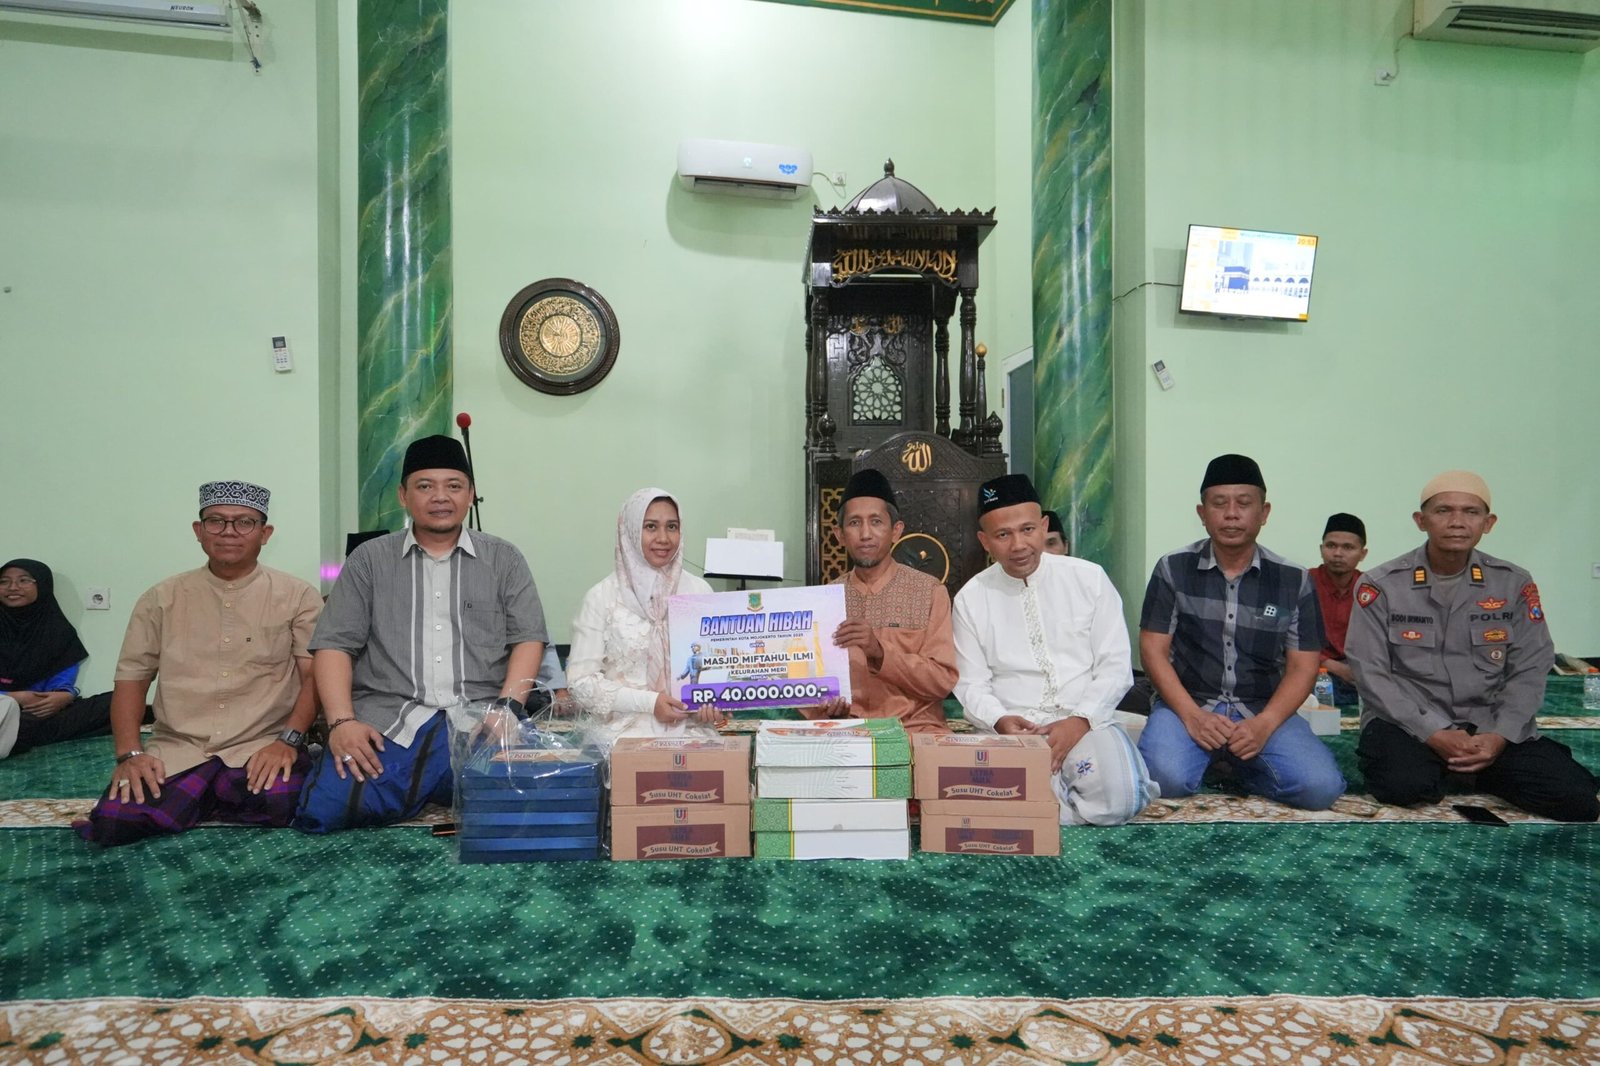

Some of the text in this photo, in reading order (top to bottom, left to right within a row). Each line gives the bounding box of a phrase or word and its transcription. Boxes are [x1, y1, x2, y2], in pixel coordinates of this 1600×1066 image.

[1470, 611, 1514, 622] POLRI
[700, 610, 813, 636] BANTUAN HIBAH
[703, 651, 814, 666] MASJID MIFTAHUL ILMI
[731, 667, 769, 675] KELURAHAN
[692, 684, 828, 703] RP. 40.000.000,-
[685, 792, 711, 800] Cokelat
[986, 789, 1013, 797] Cokelat
[686, 846, 713, 854] Cokelat
